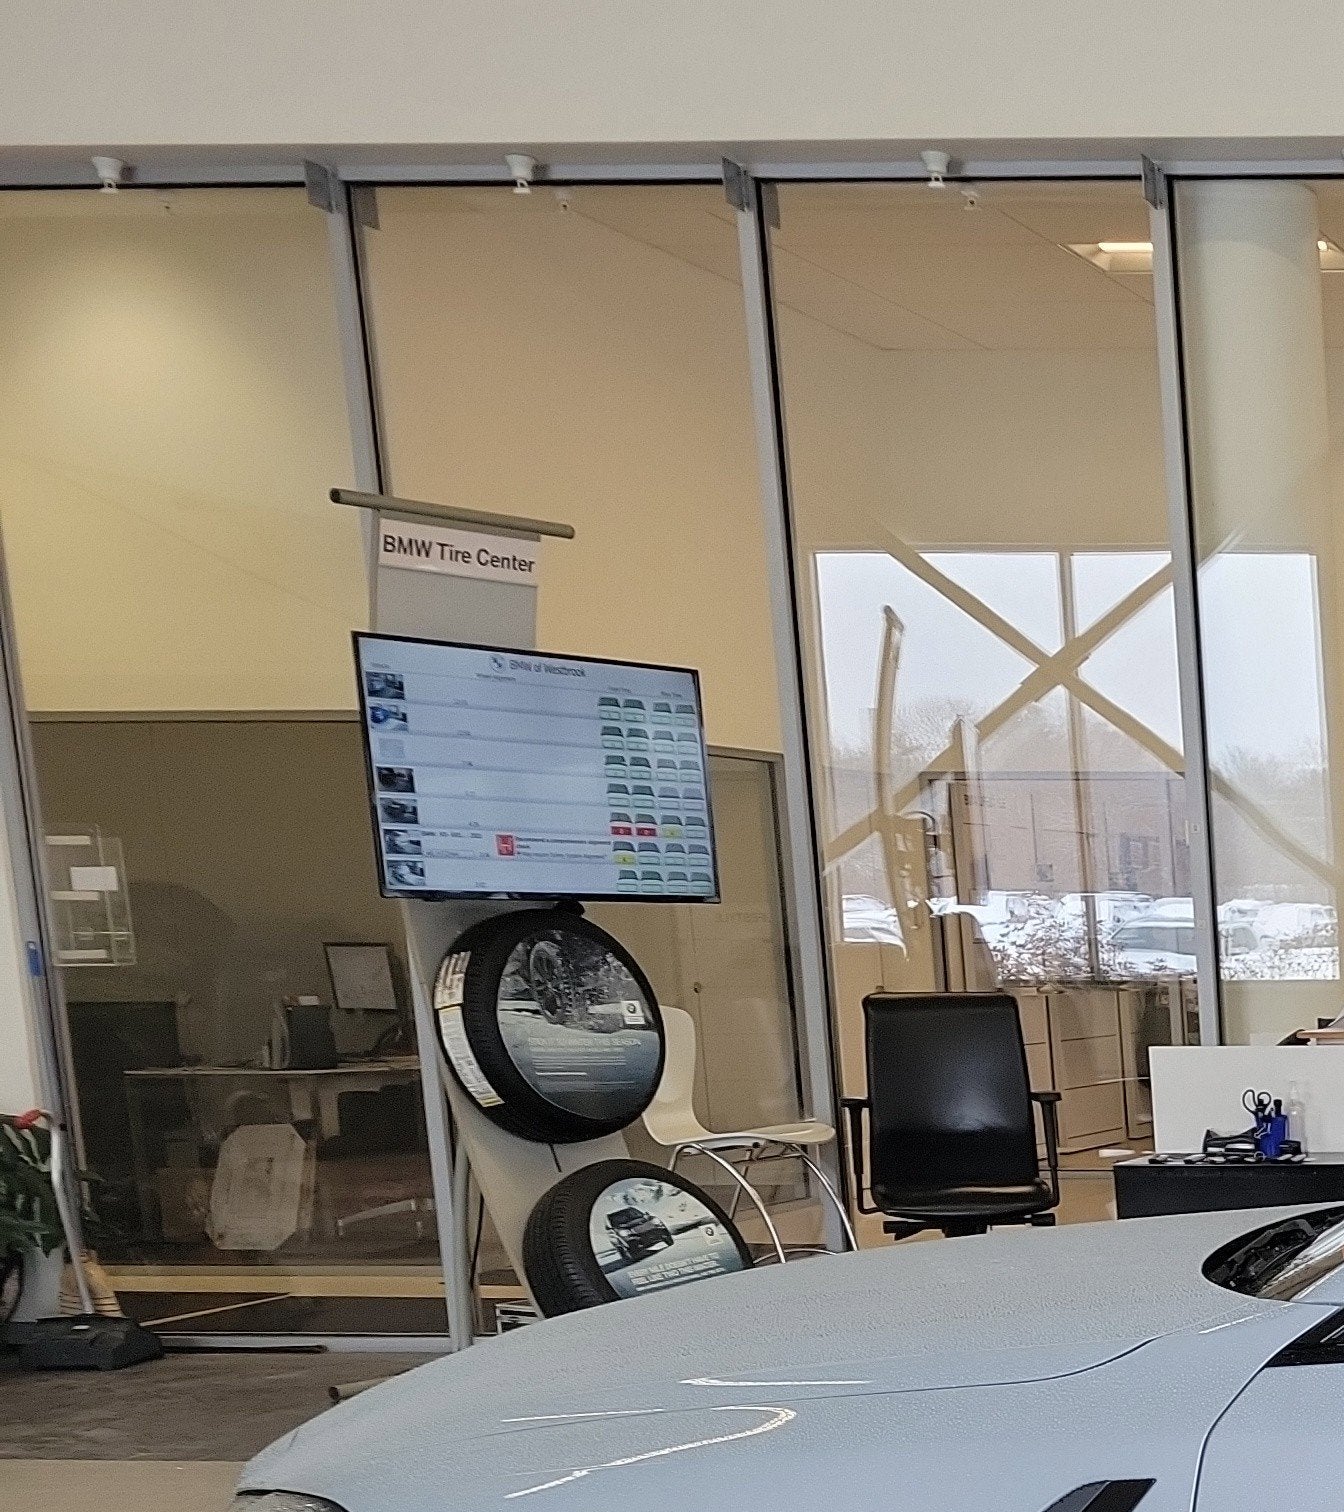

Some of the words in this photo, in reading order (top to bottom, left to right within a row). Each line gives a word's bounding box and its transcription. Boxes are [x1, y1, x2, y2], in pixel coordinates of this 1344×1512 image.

[383, 533, 433, 559] BMW
[435, 541, 473, 564] Tire
[476, 548, 536, 574] Center
